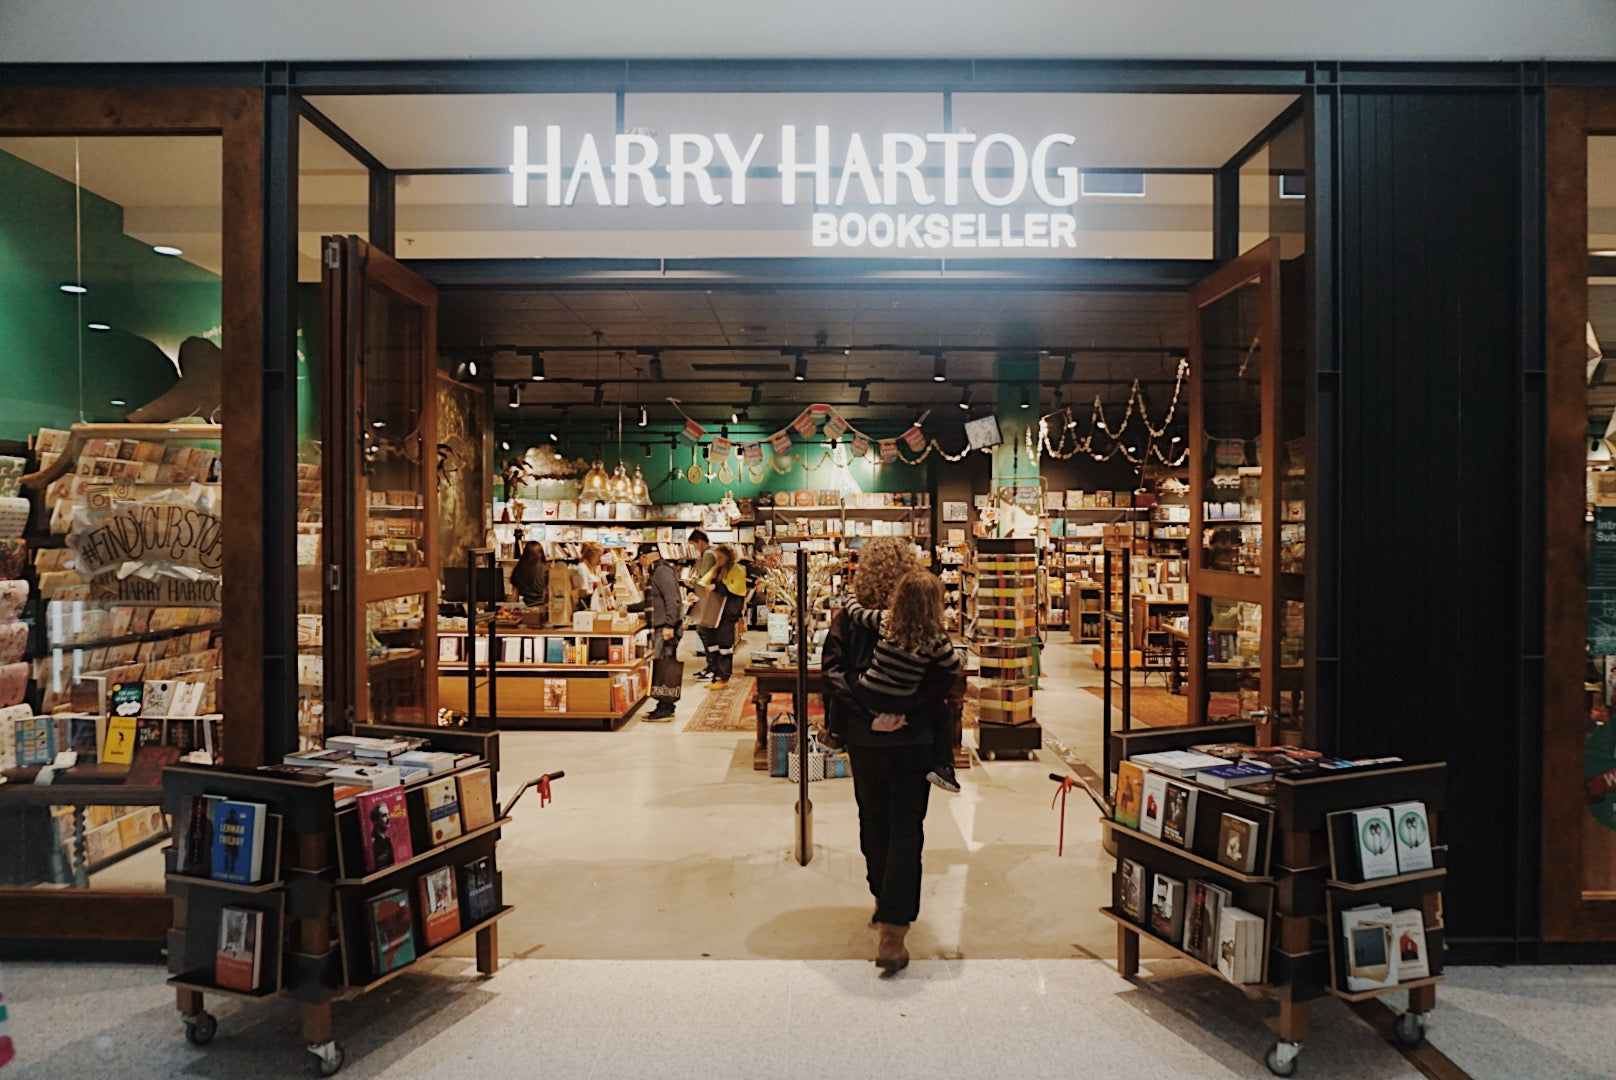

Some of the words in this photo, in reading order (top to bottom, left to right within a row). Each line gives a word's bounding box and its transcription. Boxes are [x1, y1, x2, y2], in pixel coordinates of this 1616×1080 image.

[508, 125, 764, 207] HARRY
[777, 125, 1079, 207] HARTOG
[812, 212, 1077, 248] BOOKSELLER
